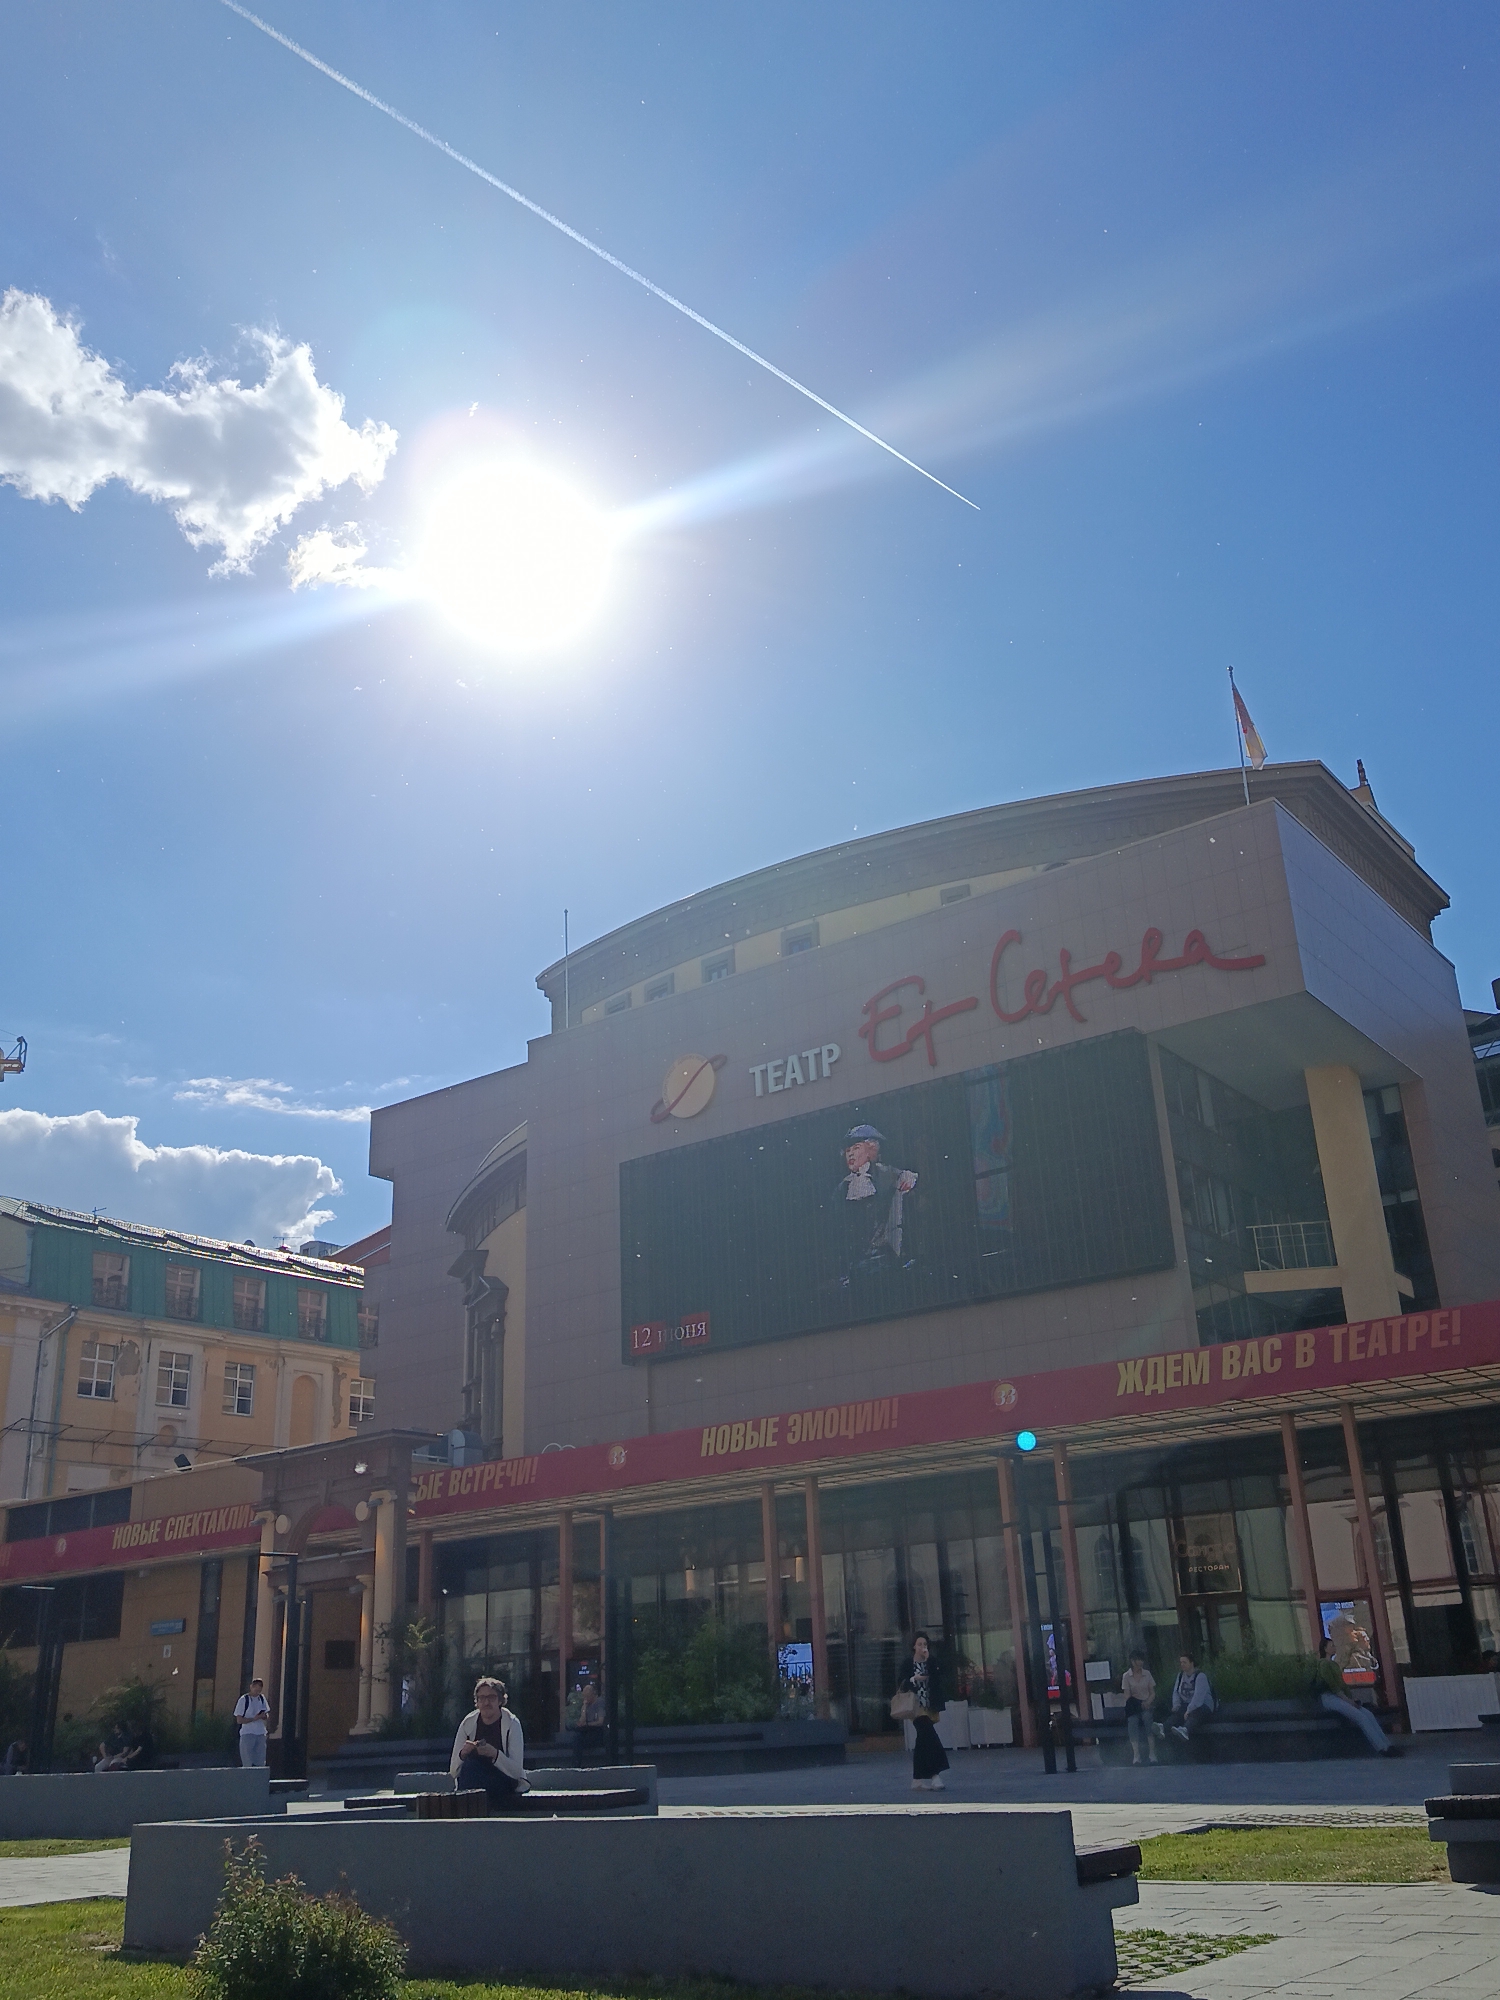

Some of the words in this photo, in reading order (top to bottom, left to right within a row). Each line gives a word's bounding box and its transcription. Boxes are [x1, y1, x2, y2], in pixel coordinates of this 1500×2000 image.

[858, 975, 978, 1066] Et
[748, 1042, 842, 1096] ТЕАТР
[633, 1327, 652, 1348] 12
[1116, 1350, 1210, 1396] ЖДЕМ
[1222, 1337, 1283, 1381] ВАС
[1295, 1332, 1316, 1369] В
[1329, 1309, 1462, 1364] ТЕАТРЕ!
[701, 1416, 780, 1457] НОВЫЕ
[787, 1397, 899, 1444] ЭМОЦИИ!
[448, 1456, 539, 1497] ВСТРЕЧИ!
[112, 1519, 162, 1549] НОВЫЕ
[1188, 1564, 1230, 1573] РЕСТОРАН
